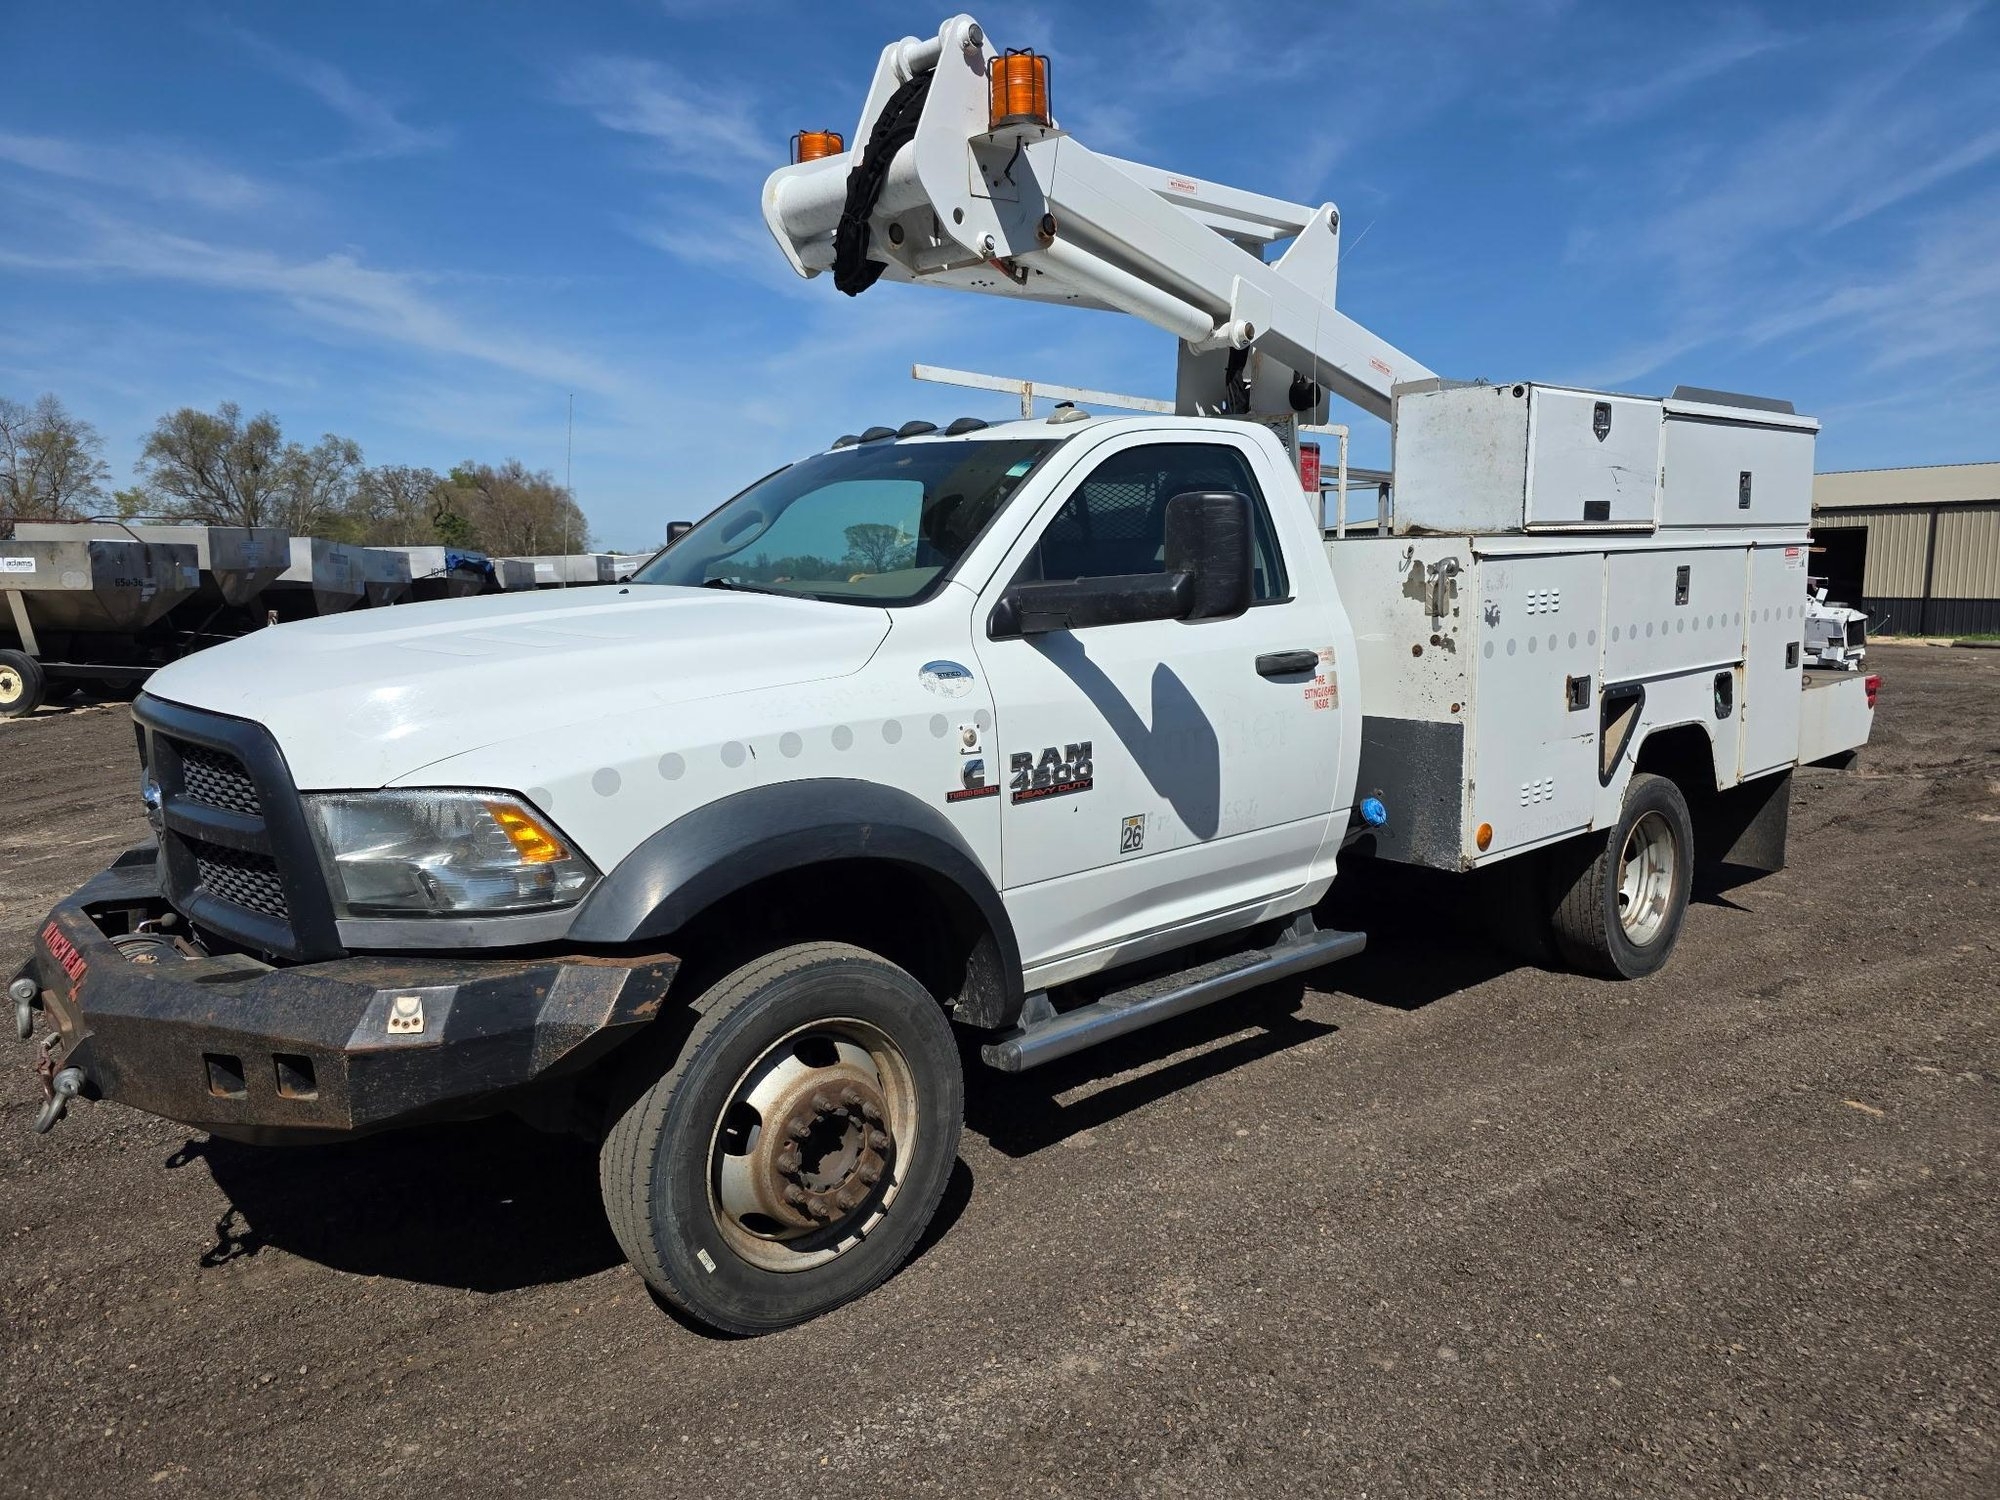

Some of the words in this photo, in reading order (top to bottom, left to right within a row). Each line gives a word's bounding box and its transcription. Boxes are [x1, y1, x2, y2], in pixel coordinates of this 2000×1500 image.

[6, 559, 33, 567] adams
[1304, 685, 1337, 699] EXTINGUISHER
[1314, 698, 1329, 709] INSIDE
[1010, 741, 1092, 773] RAM
[1010, 758, 1093, 789] 4500
[950, 791, 973, 800] TURBO
[973, 786, 998, 797] DIESEL
[1015, 786, 1057, 800] HEAVY
[1058, 780, 1091, 793] DUTY
[1123, 825, 1141, 850] 26
